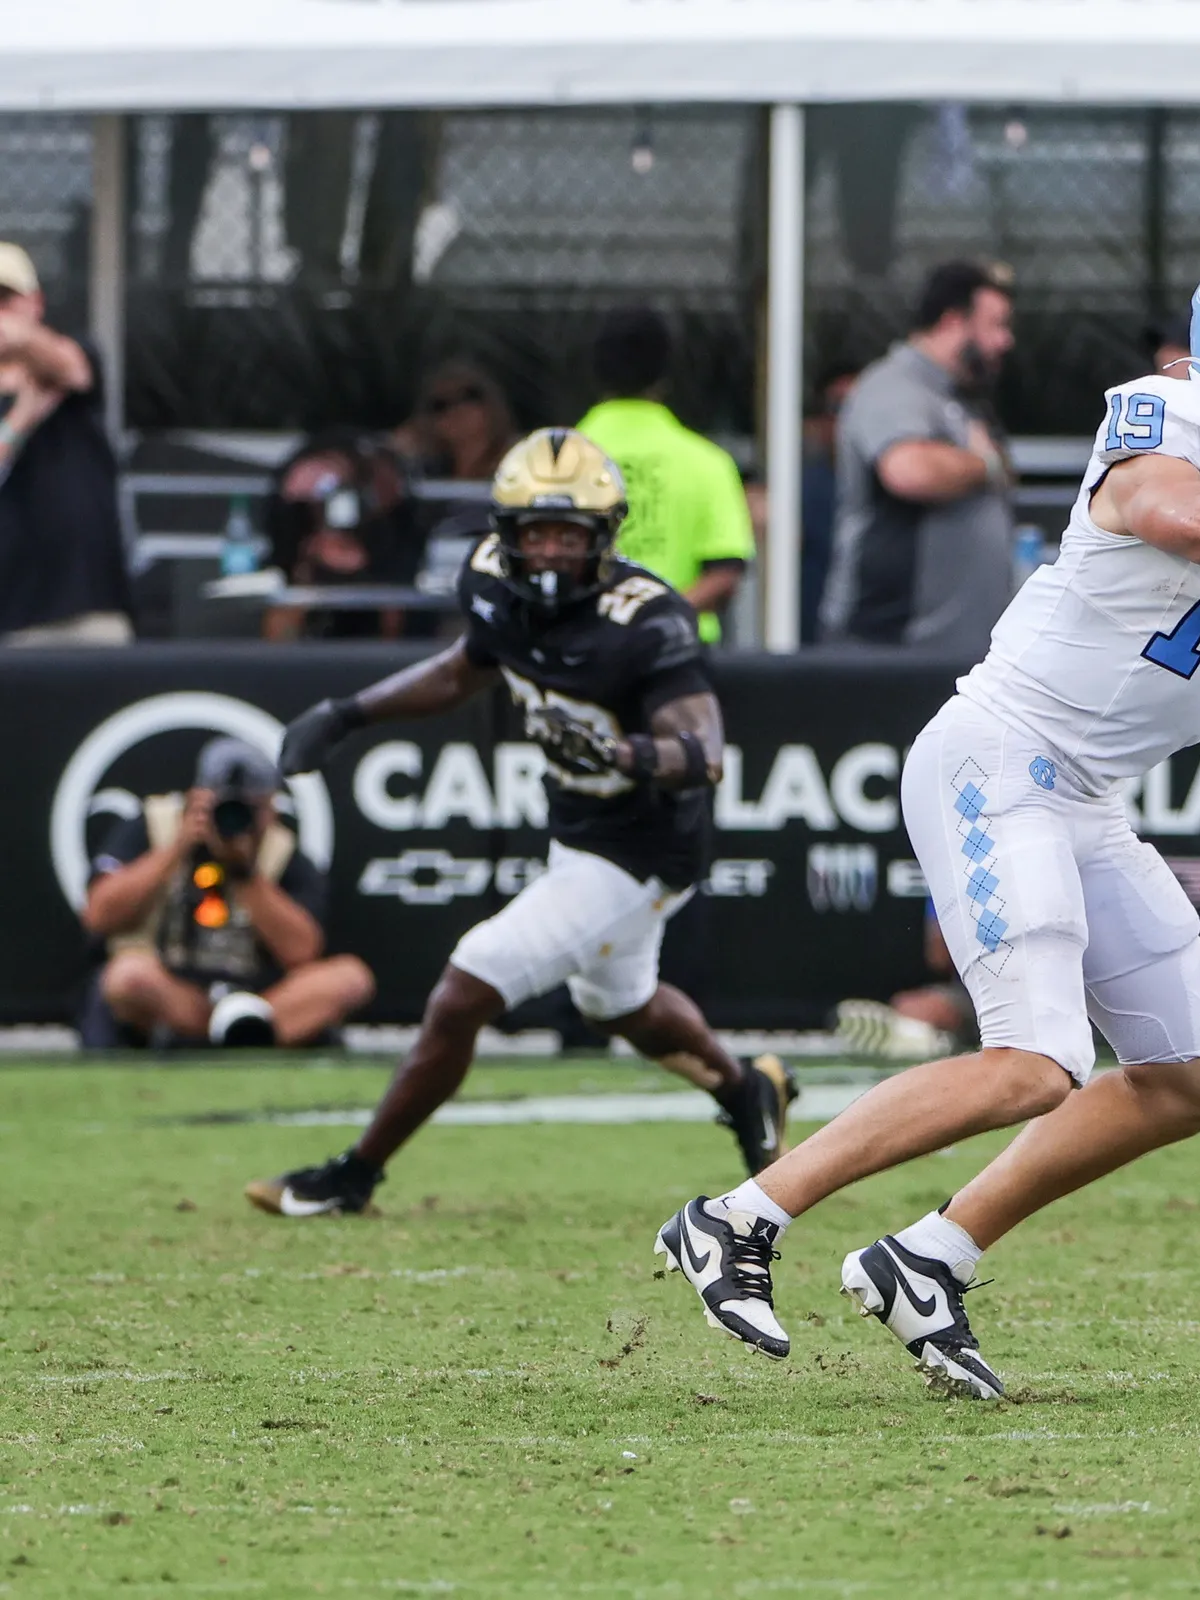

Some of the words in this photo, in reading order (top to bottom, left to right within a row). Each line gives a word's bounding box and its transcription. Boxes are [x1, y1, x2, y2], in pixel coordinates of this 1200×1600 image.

[1105, 393, 1166, 451] 19
[353, 740, 550, 831] CAR
[714, 742, 910, 833] LAC
